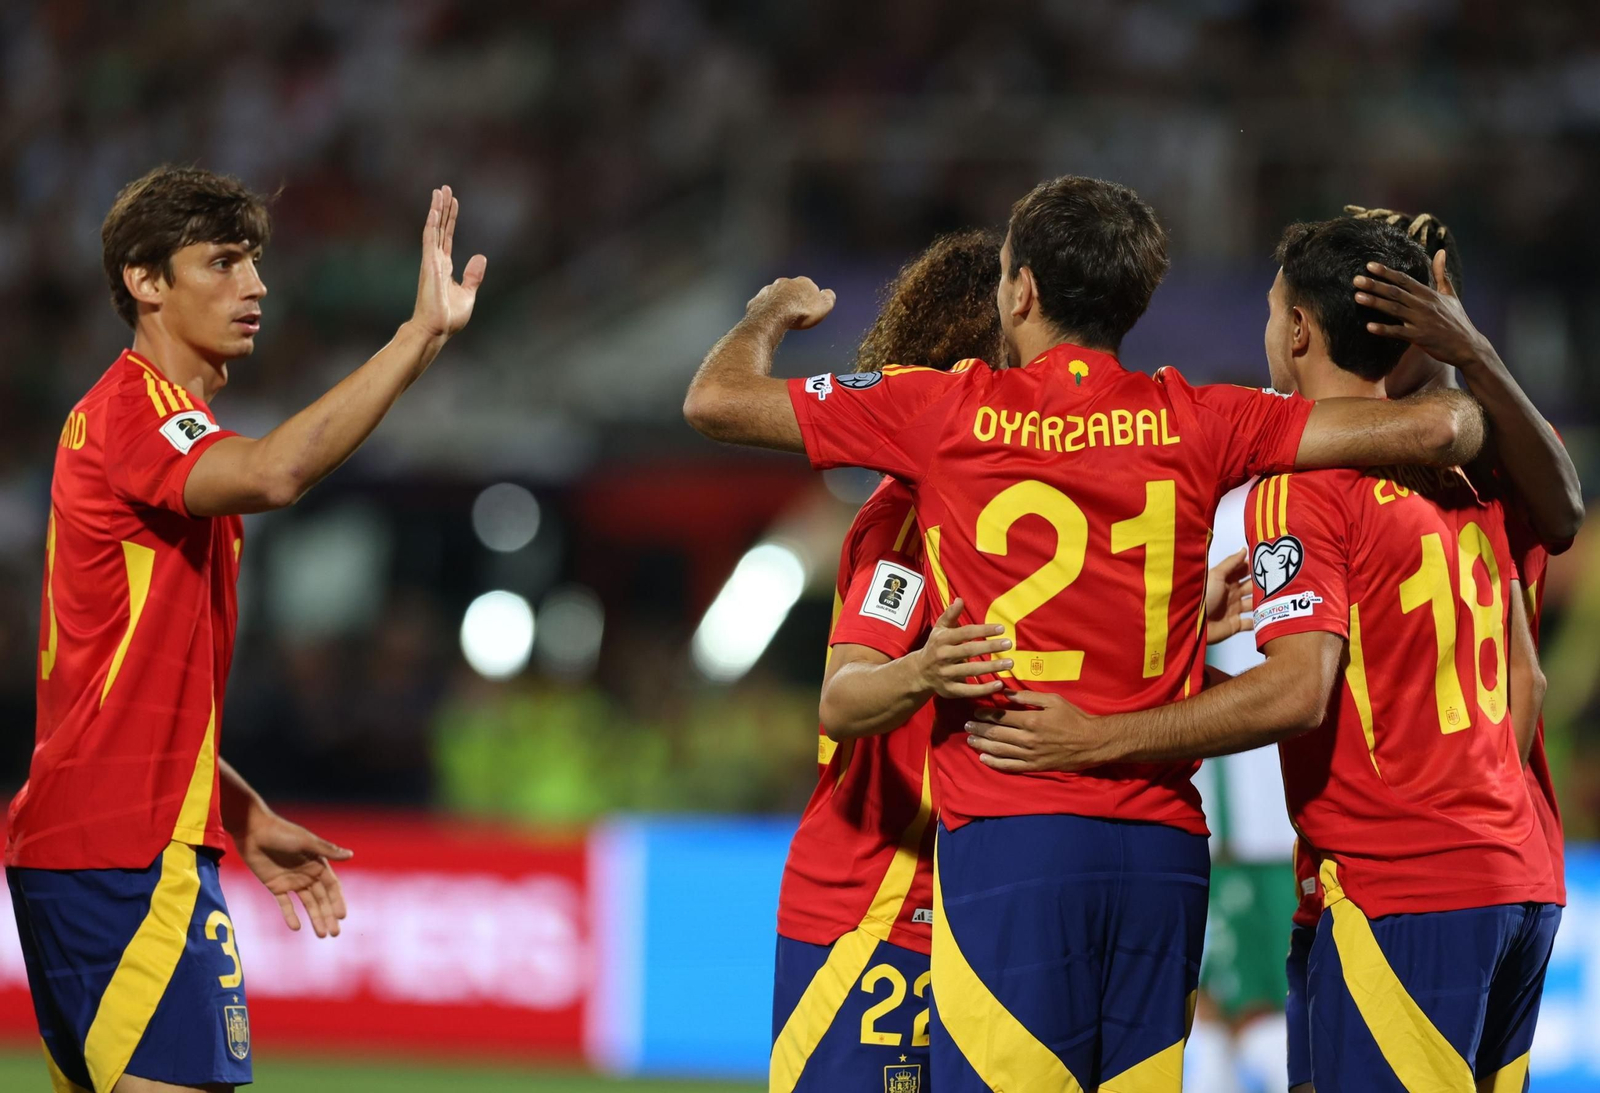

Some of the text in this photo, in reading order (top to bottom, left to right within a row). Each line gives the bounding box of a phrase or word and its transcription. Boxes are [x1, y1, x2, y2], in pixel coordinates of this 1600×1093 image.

[973, 406, 1181, 453] OYARZABAL
[976, 479, 1175, 682] 21
[1399, 521, 1508, 735] 18
[205, 910, 243, 988] 3
[860, 963, 930, 1046] 22
